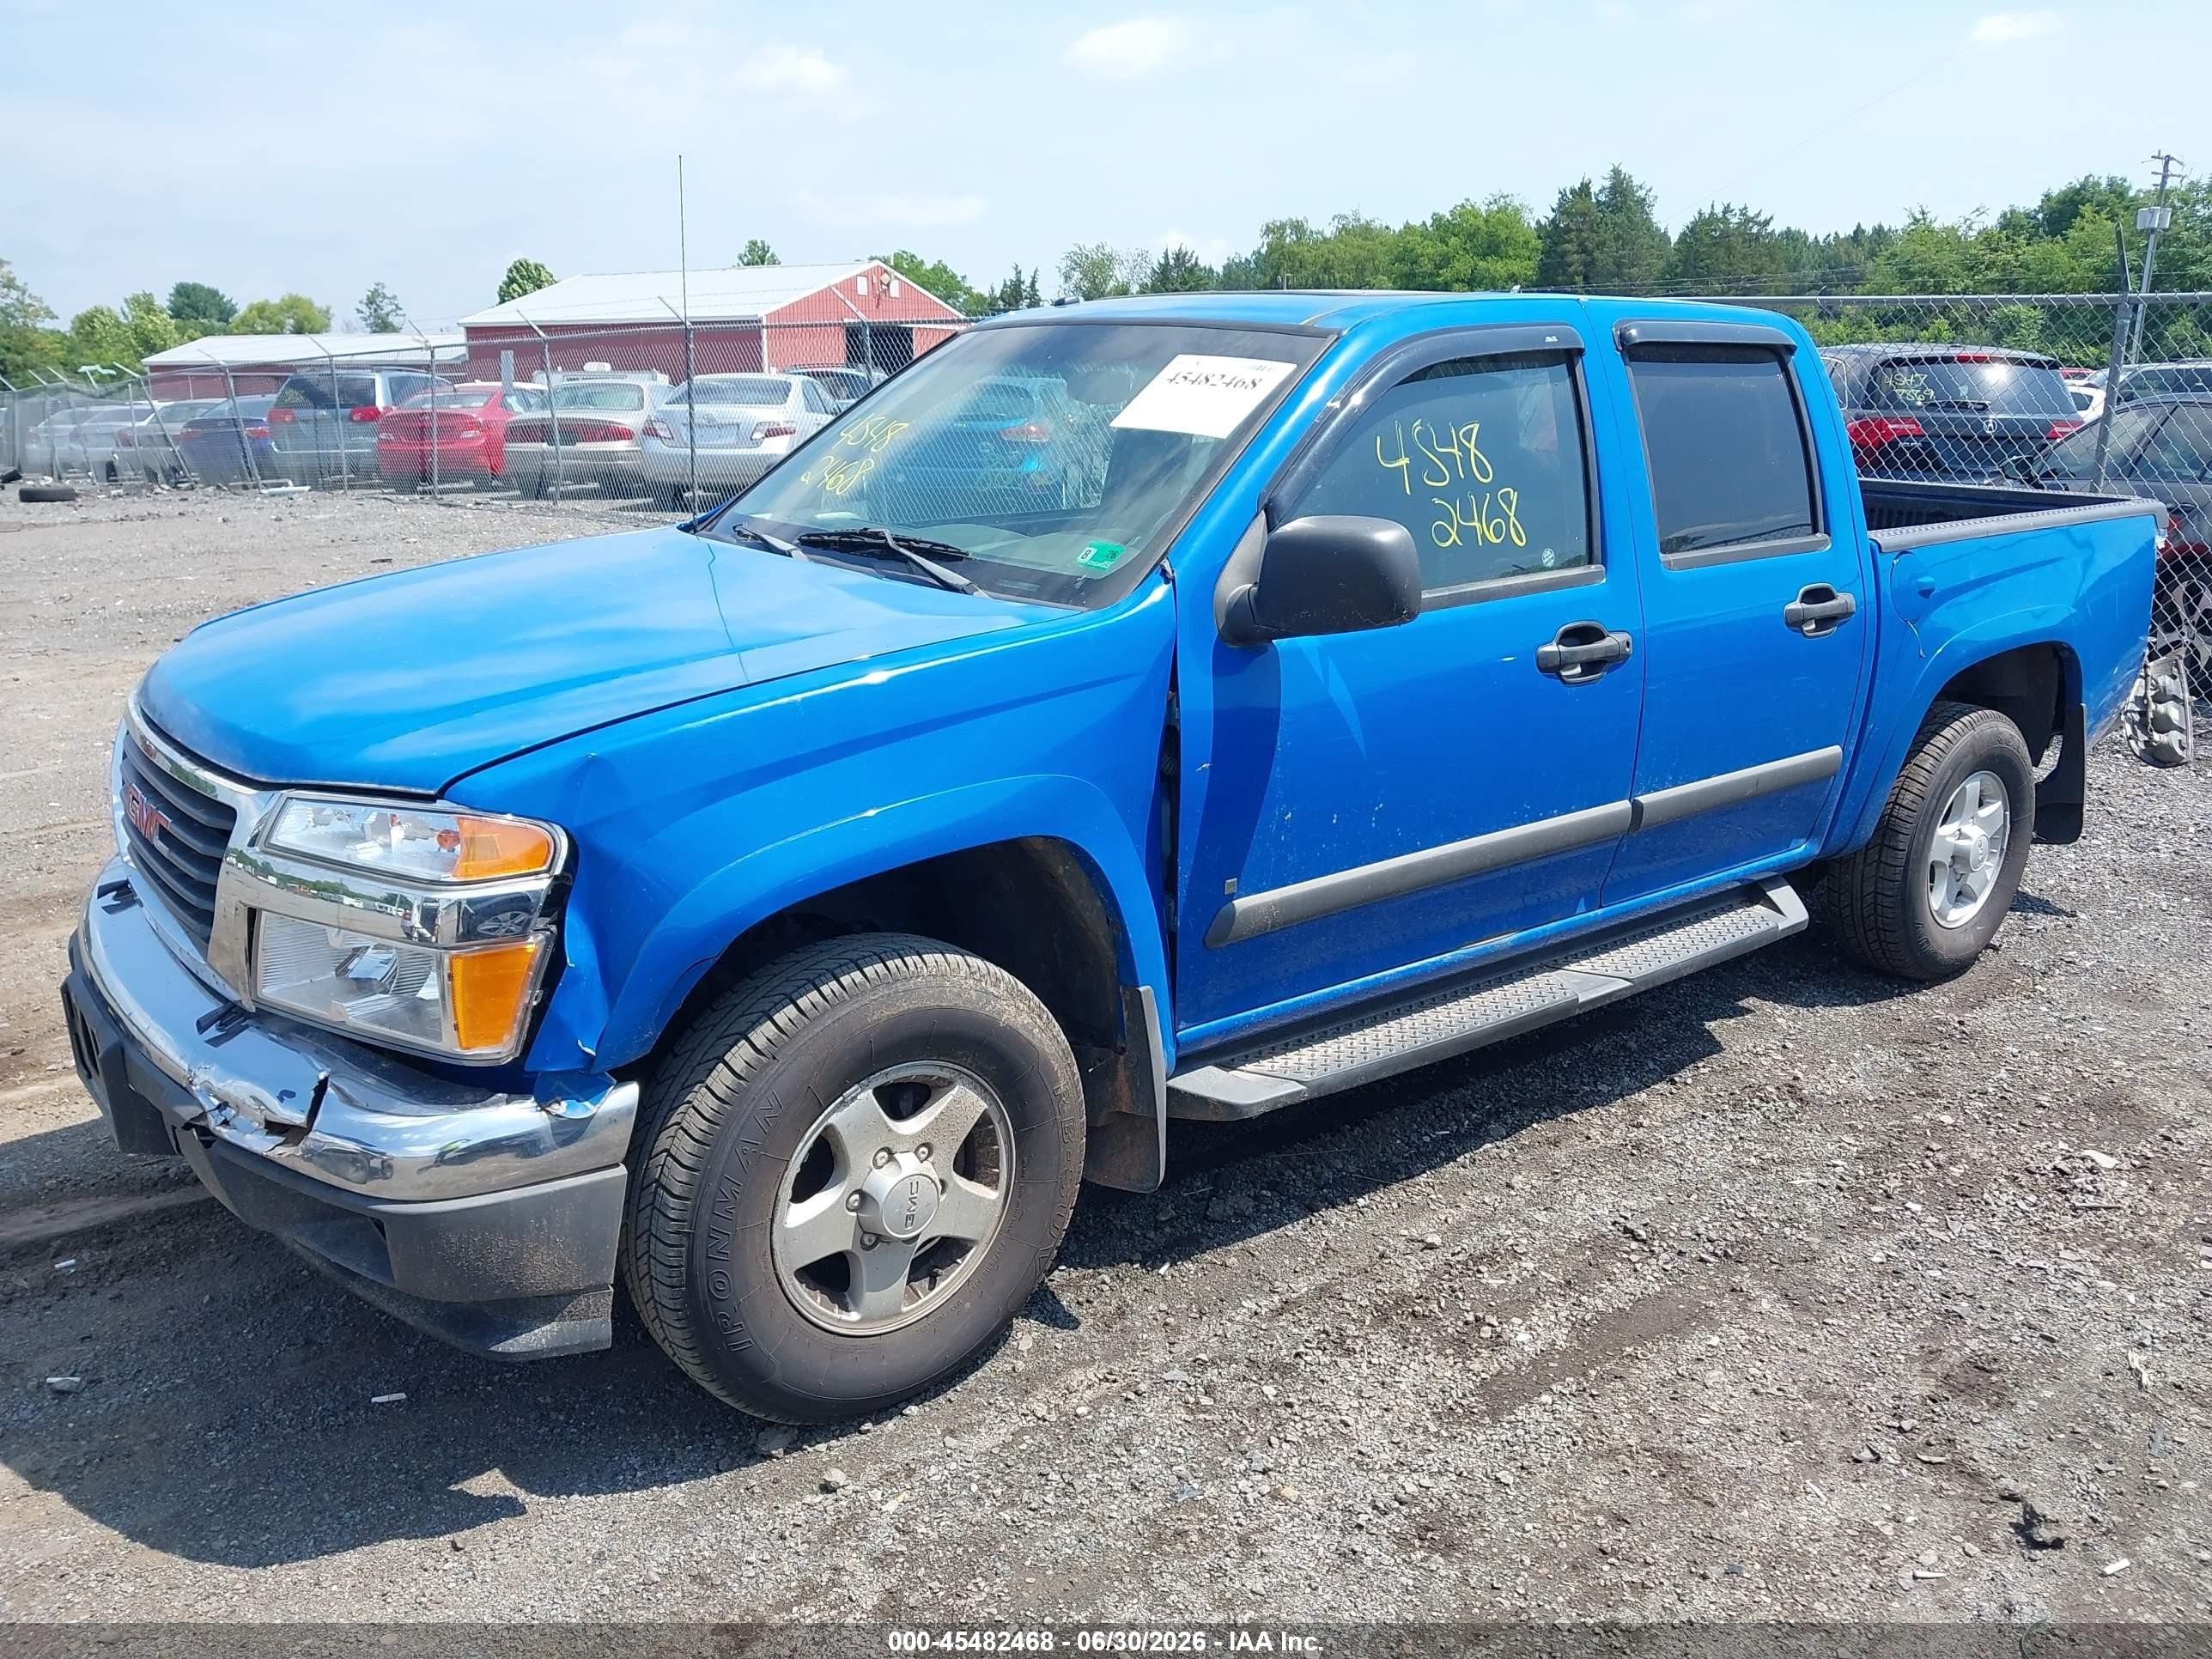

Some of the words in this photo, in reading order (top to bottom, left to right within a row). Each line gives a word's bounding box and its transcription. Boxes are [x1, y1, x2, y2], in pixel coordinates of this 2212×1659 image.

[1166, 371, 1263, 391] 45482468
[832, 413, 909, 453] 4548
[1376, 419, 1493, 495] 4548
[800, 454, 874, 495] 2468
[1431, 487, 1527, 548] 2468
[127, 782, 173, 853] GMC
[708, 1089, 783, 1353] IRONMAN
[903, 1180, 920, 1231] GMC
